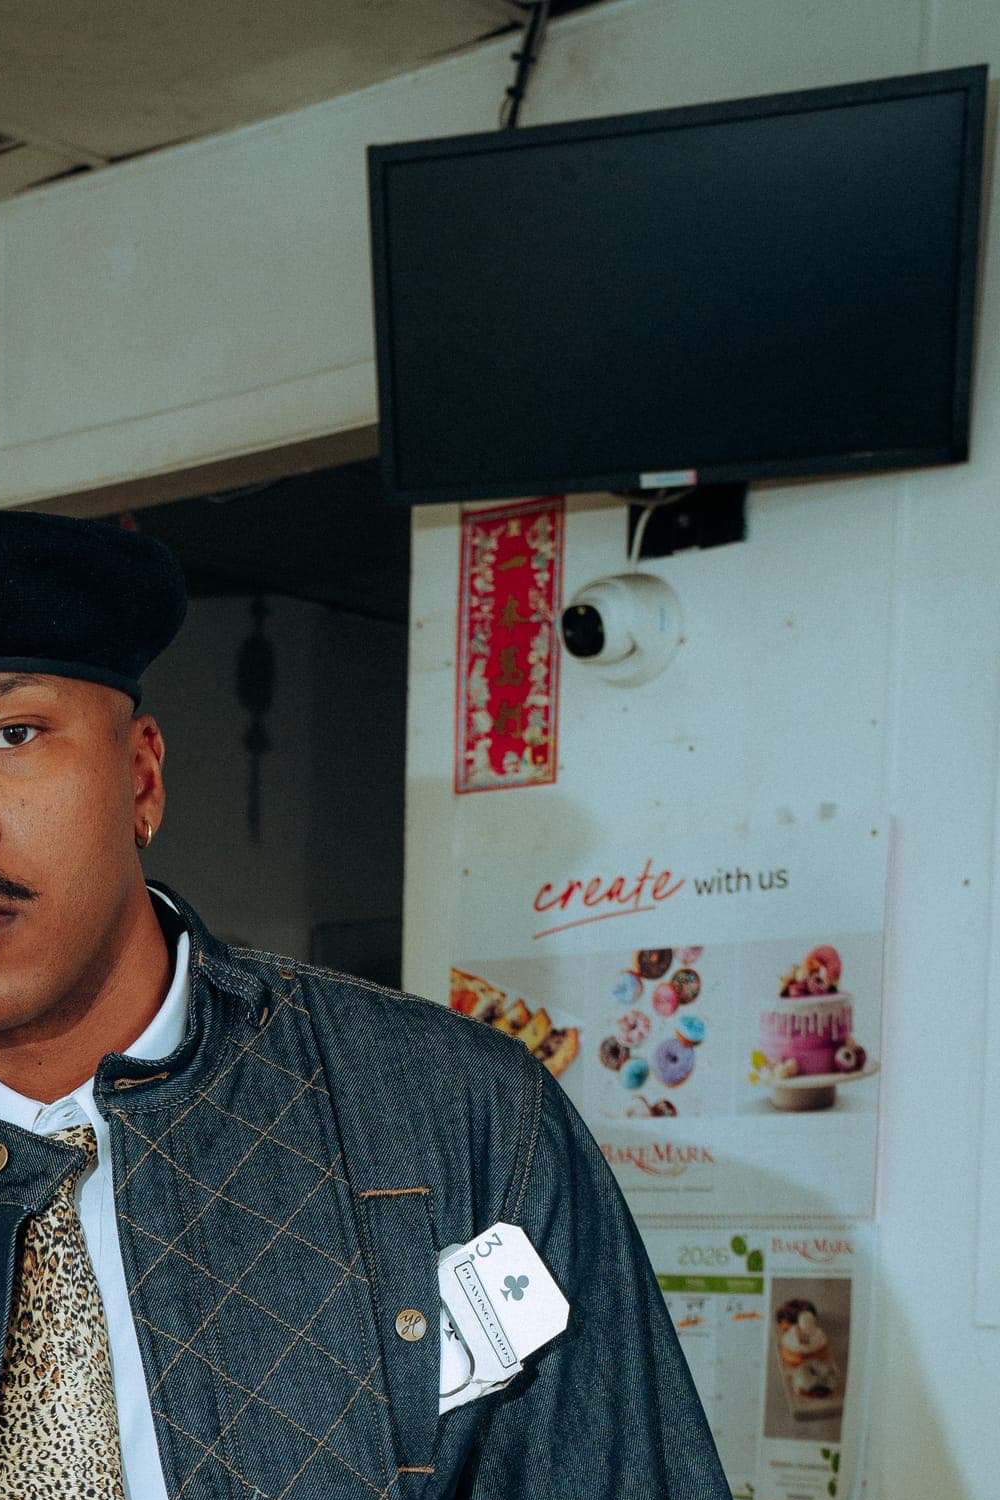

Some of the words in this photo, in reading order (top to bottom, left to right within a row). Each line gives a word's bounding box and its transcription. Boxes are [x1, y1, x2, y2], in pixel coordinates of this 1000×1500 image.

[532, 858, 686, 914] create
[694, 867, 752, 896] with
[758, 867, 790, 891] us
[462, 1267, 491, 1321] PLAYING
[490, 1321, 512, 1364] CARDS
